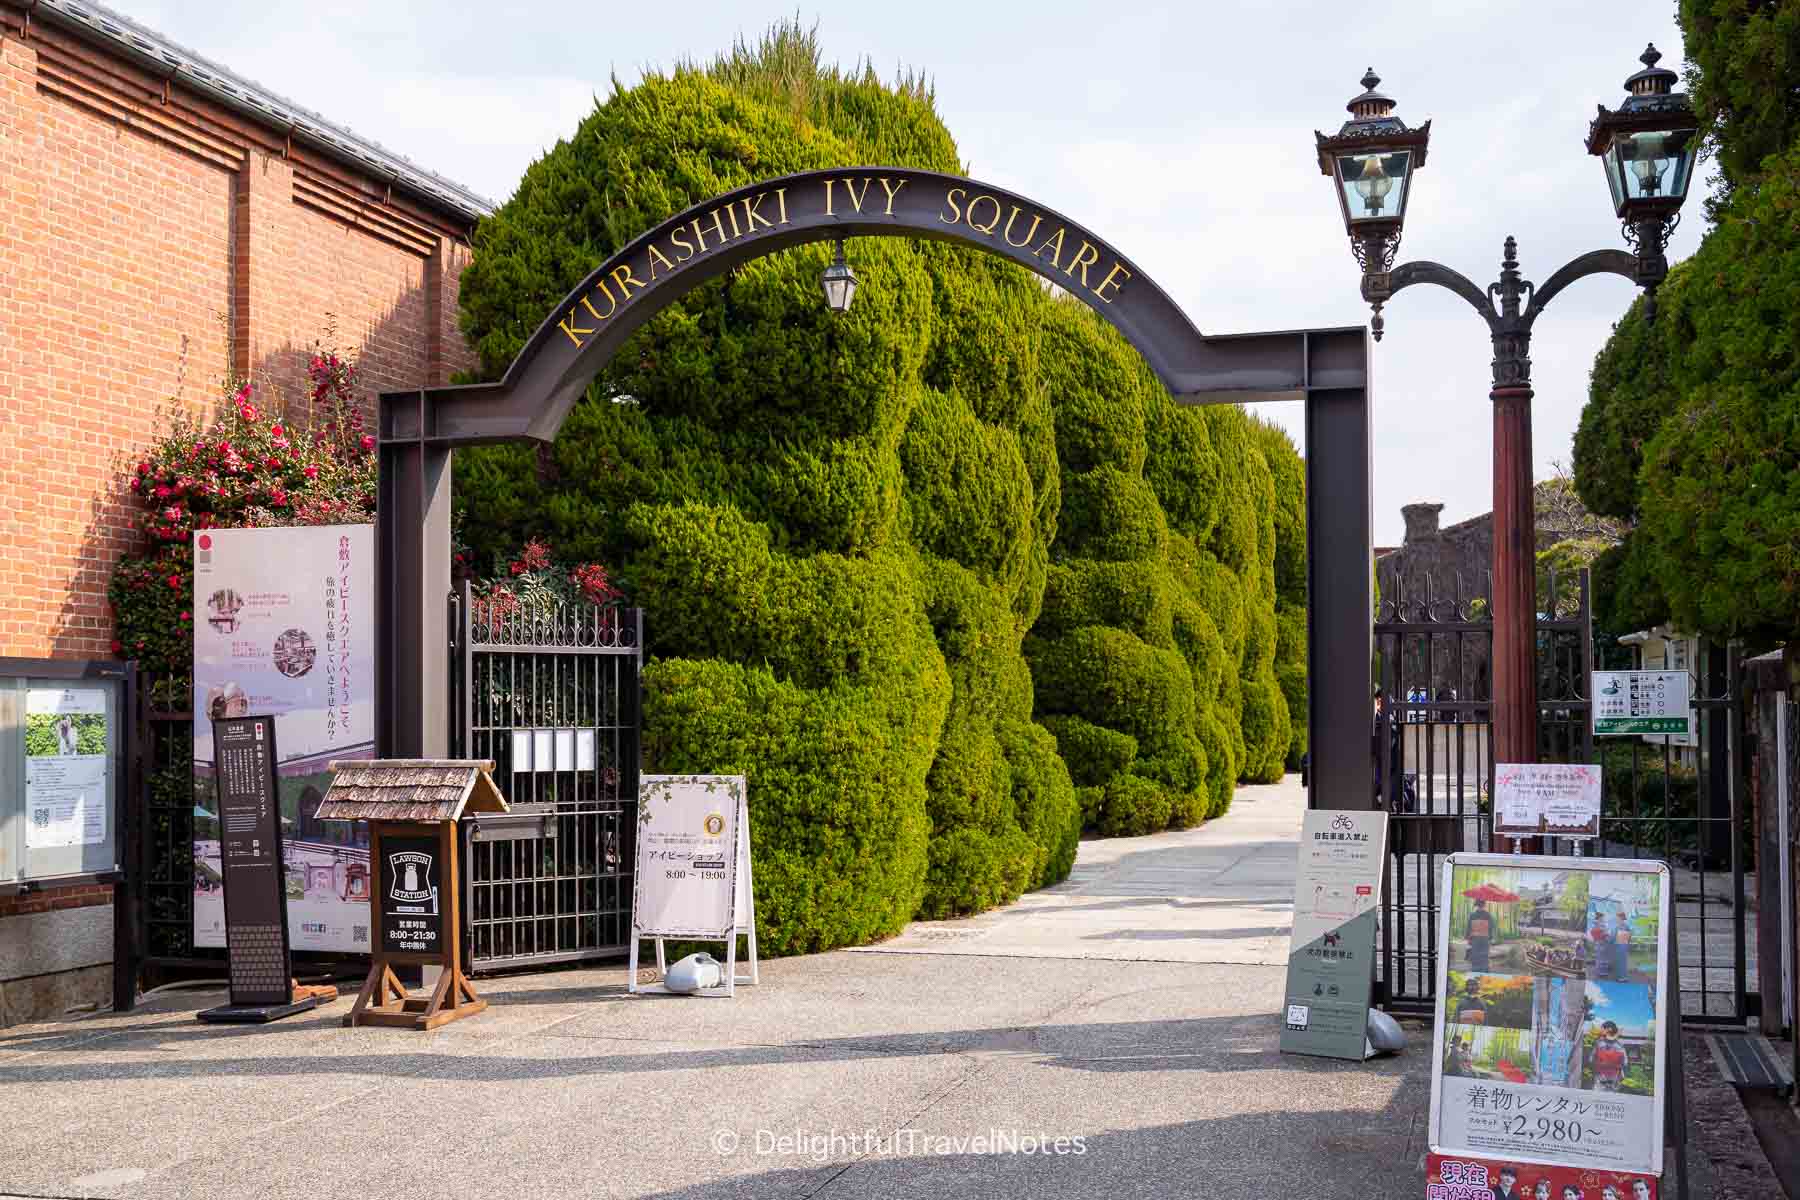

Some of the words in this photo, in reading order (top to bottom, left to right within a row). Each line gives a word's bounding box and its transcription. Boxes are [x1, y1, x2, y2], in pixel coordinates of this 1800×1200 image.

[556, 188, 791, 350] KURASHIKI
[823, 177, 910, 217] IVY
[938, 188, 1133, 304] SQUARE
[393, 854, 429, 865] LAWSON
[648, 850, 724, 862] アイビーショップ
[665, 871, 686, 880] 8:00
[700, 871, 726, 880] 19:00
[394, 888, 429, 899] STATION
[1466, 1085, 1592, 1115] 着物レンタル
[1441, 1161, 1488, 1186] 現在
